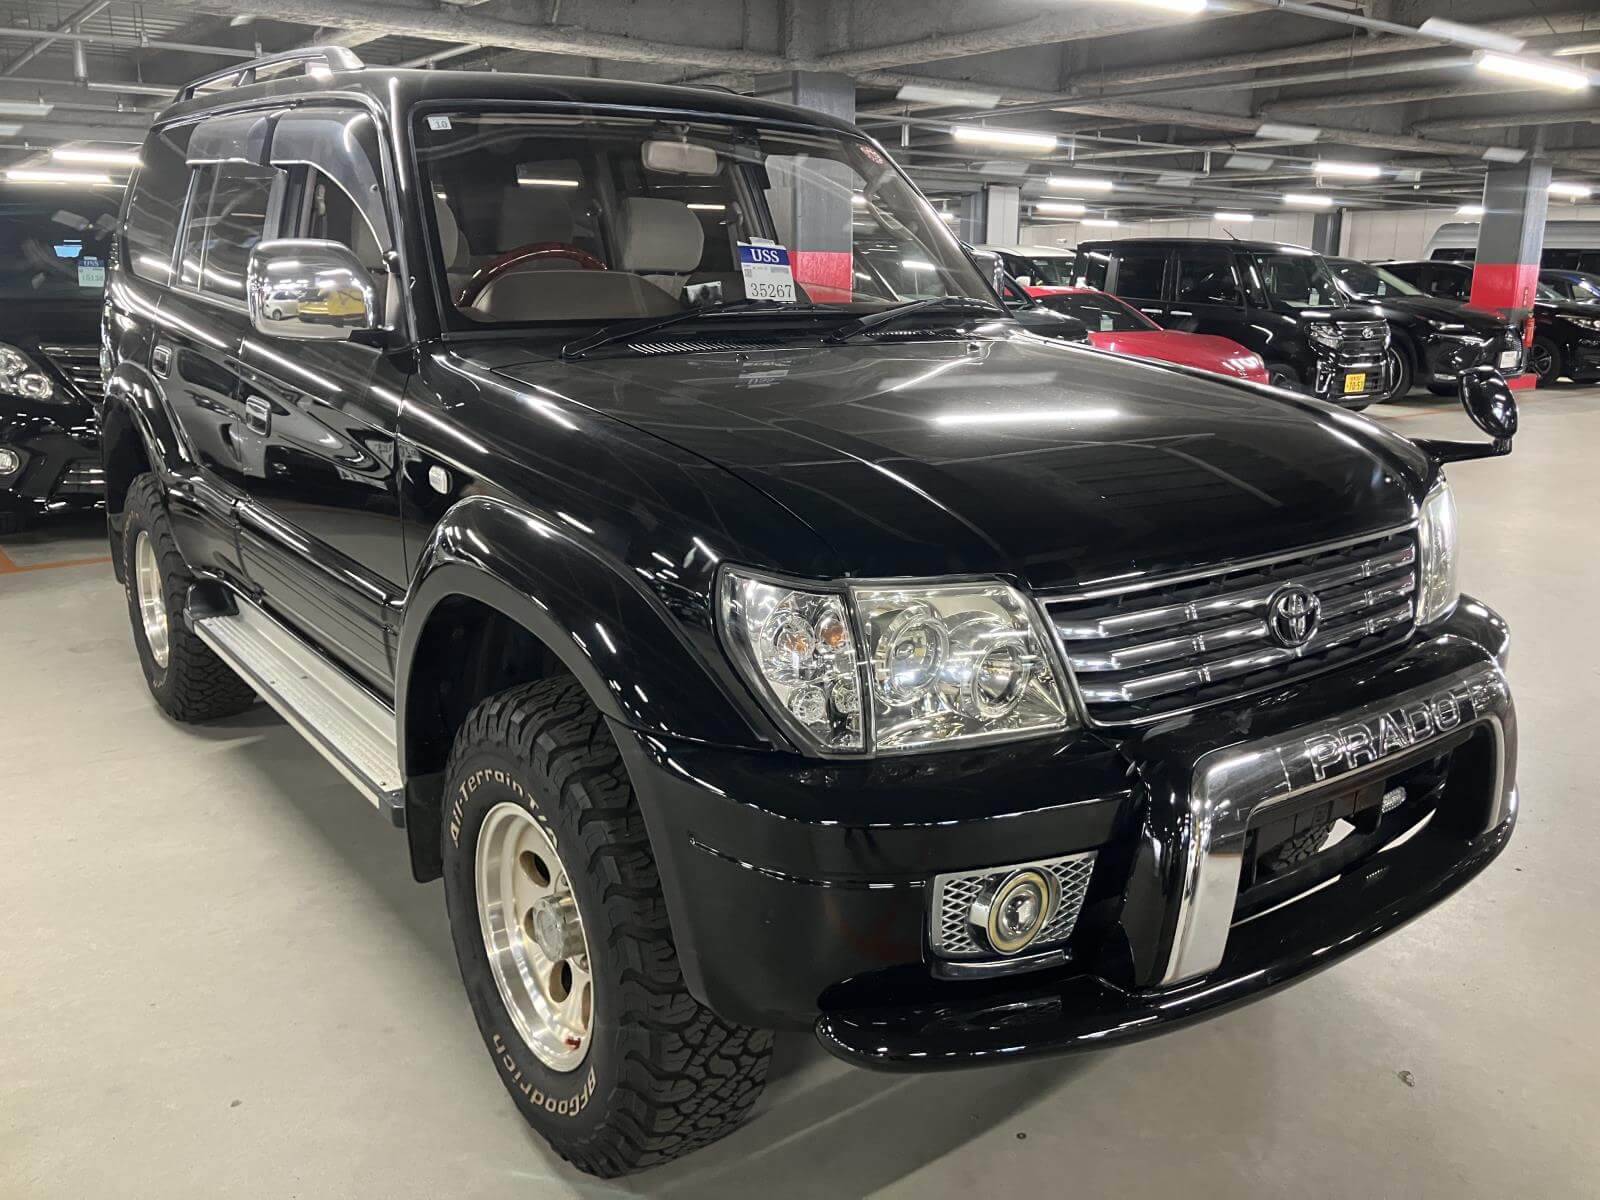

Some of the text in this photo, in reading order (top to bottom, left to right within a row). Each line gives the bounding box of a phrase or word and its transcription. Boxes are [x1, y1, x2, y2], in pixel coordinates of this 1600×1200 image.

[750, 248, 780, 263] USS
[750, 282, 792, 298] 35267
[1303, 690, 1461, 782] PRADO
[450, 768, 524, 849] All-Terrain
[493, 1034, 597, 1117] BFGoodrich
